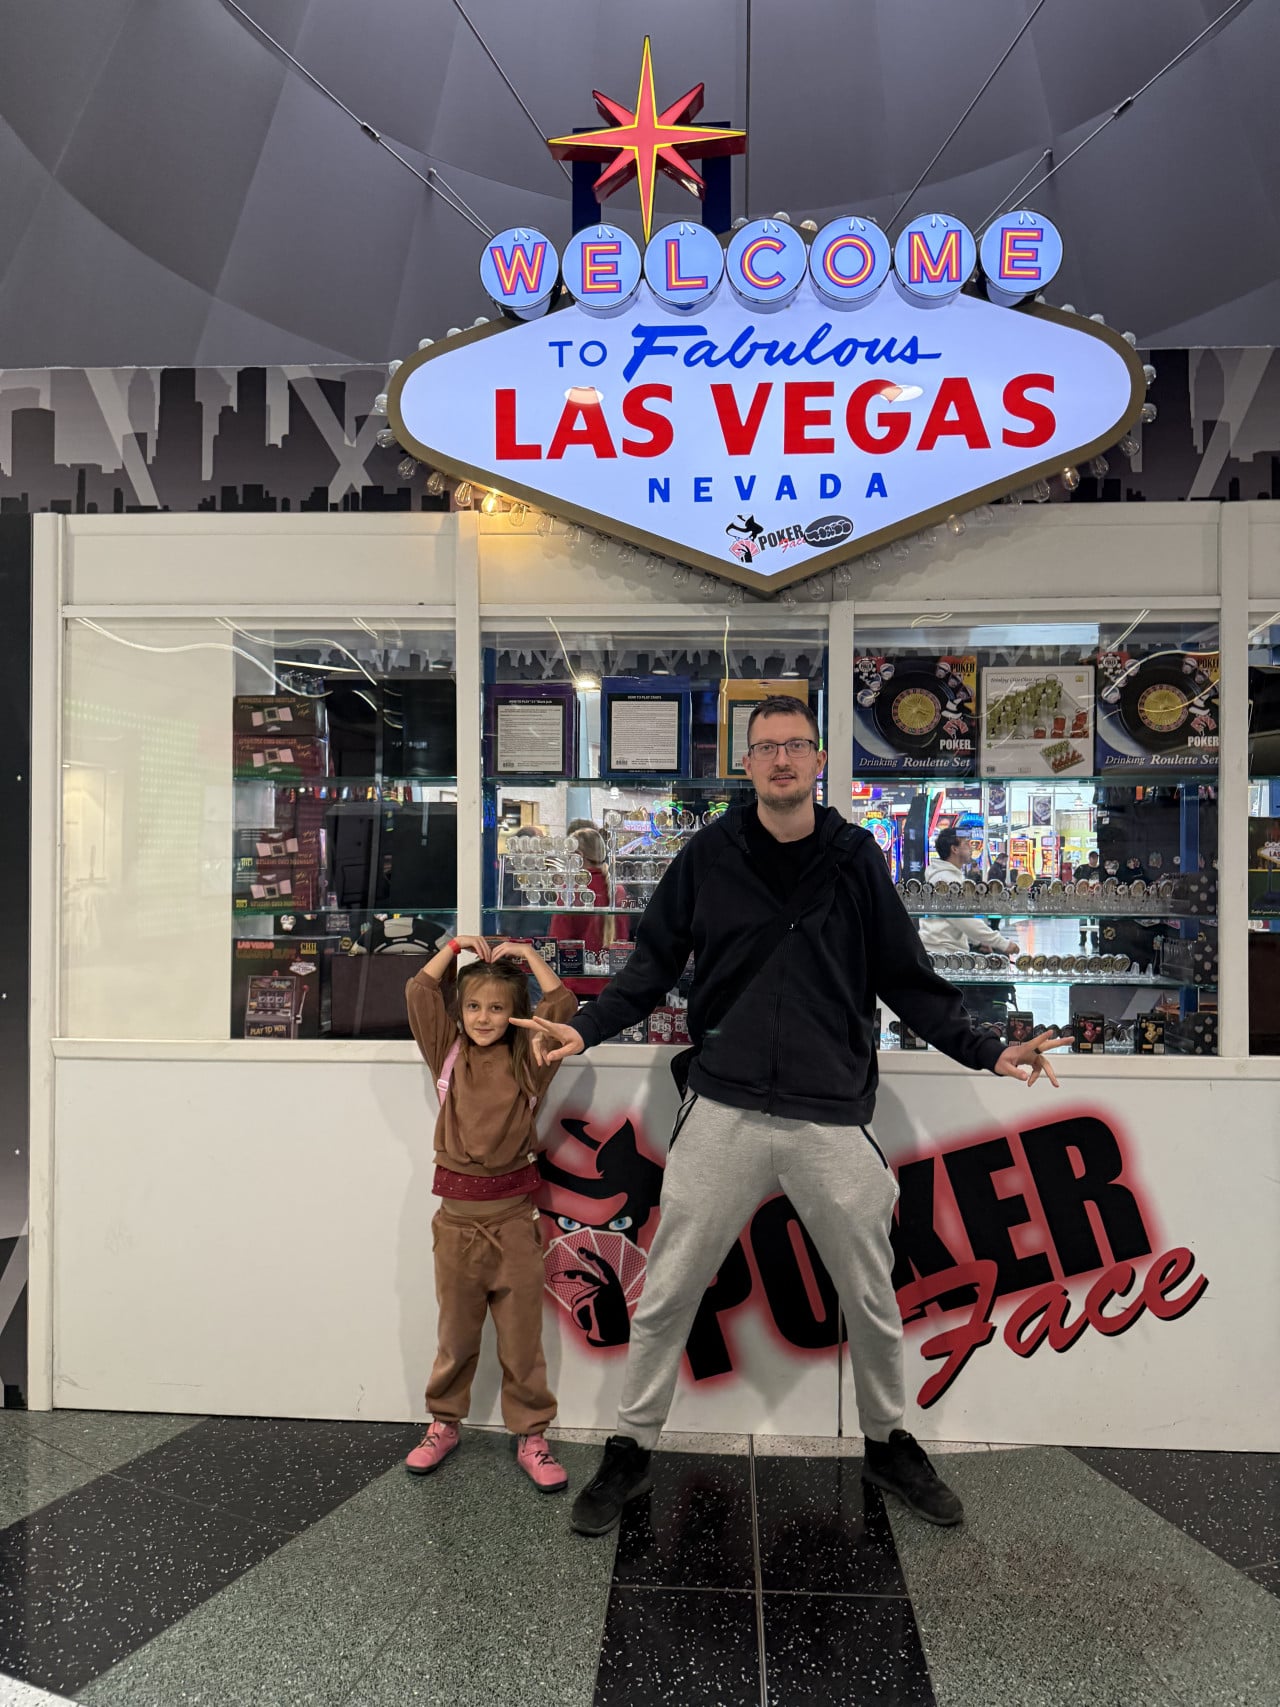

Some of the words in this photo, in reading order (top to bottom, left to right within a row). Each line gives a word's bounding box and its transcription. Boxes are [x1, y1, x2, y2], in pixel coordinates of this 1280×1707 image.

[490, 227, 1044, 297] WELCOME
[549, 340, 609, 369] TO
[622, 322, 942, 382] Fabulous
[495, 383, 674, 461] LAS
[710, 373, 1056, 457] VEGAS
[648, 472, 888, 504] NEVADA
[758, 524, 805, 551] POKER
[951, 663, 975, 673] POKER
[940, 739, 971, 750] POKER
[1188, 736, 1219, 748] POKER
[859, 758, 898, 768] Drinking
[903, 757, 950, 767] Roulette
[952, 757, 971, 767] Set
[1105, 755, 1146, 766] Drinking
[1150, 754, 1198, 765] Roulette
[250, 1027, 263, 1036] PLAY
[264, 1025, 273, 1033] TO
[273, 1024, 287, 1032] WIN
[685, 1116, 1152, 1381] POKER
[895, 1246, 1210, 1408] Face
